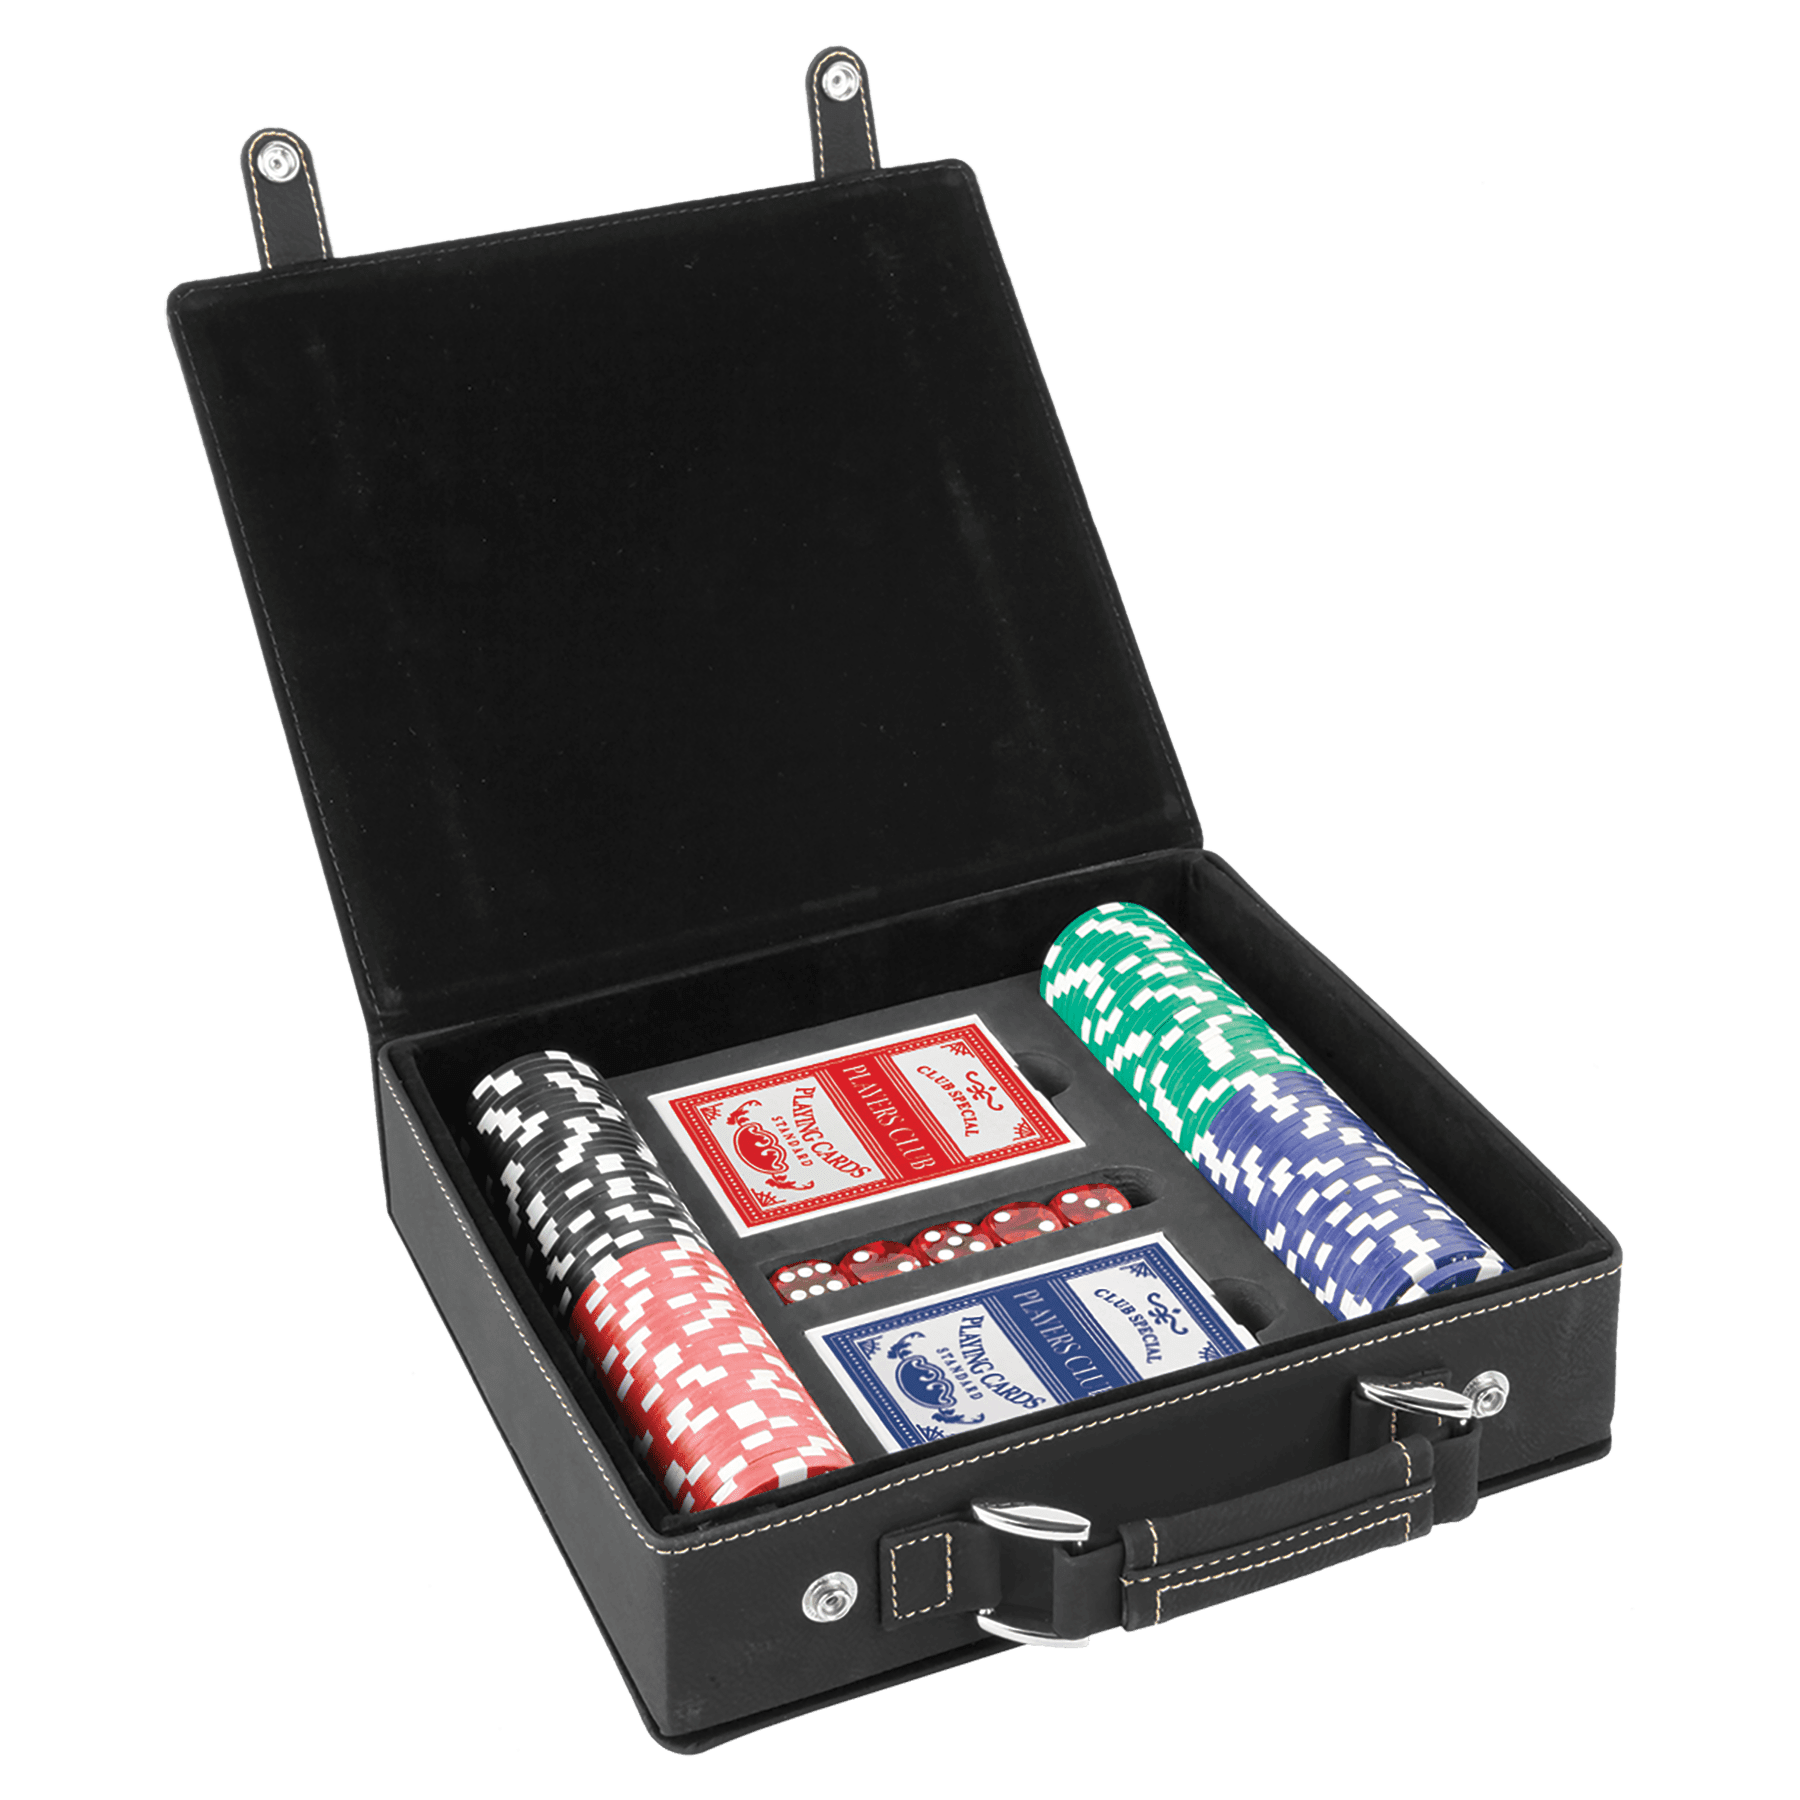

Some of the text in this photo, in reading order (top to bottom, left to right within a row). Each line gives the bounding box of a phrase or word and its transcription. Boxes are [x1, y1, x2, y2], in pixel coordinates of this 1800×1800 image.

[792, 1086, 872, 1178] PLAYING CARDS
[843, 1064, 936, 1170] PLAYERS CLUB
[917, 1065, 980, 1138] CLUB SPECIAL
[771, 1115, 814, 1167] STANDARD
[1013, 1289, 1082, 1355] PLAYERS
[1093, 1288, 1163, 1365] CLUB SPECIAL
[936, 1347, 984, 1401] STANDARD
[959, 1315, 1047, 1409] PLAYING CARDS
